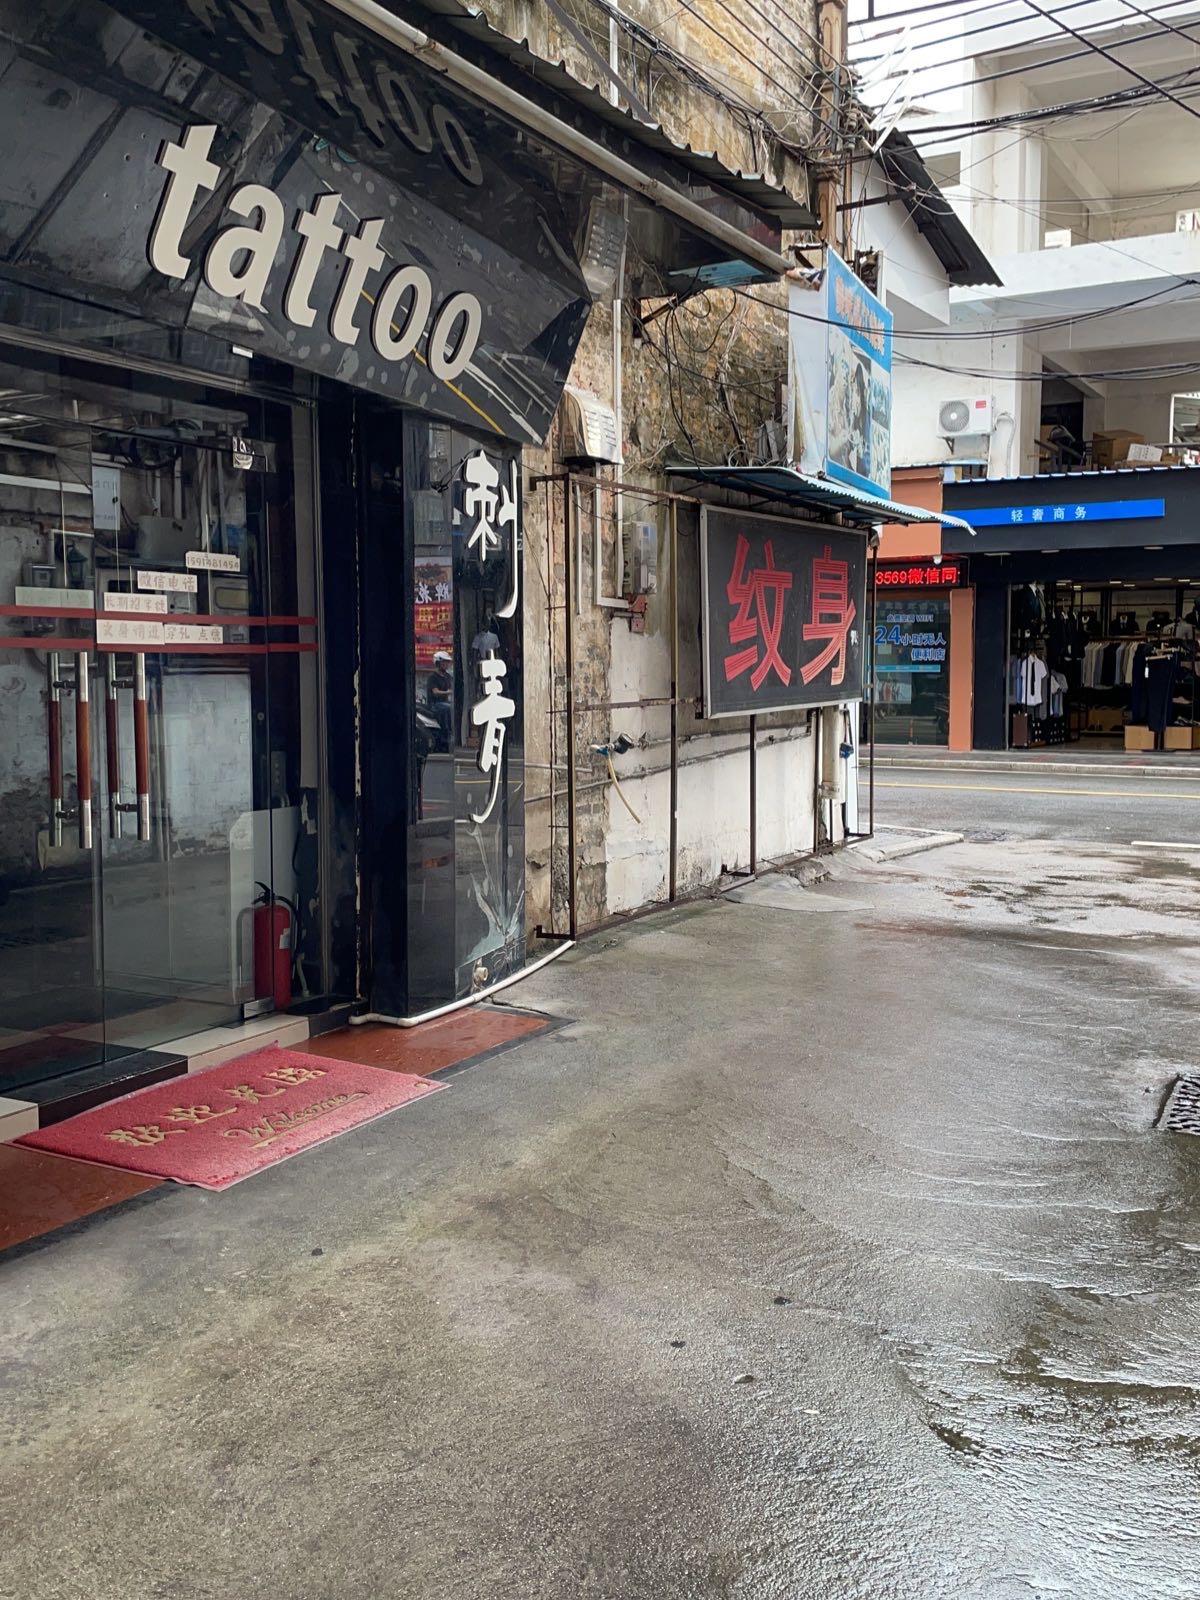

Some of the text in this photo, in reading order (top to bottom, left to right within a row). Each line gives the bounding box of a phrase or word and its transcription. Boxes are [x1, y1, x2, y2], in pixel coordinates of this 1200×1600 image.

[147, 124, 482, 381] tattoo
[1010, 506, 1087, 522] 轻奢商务
[724, 533, 857, 692] 纹身
[875, 567, 960, 585] 3569微信同
[465, 449, 519, 823] 刺青
[911, 648, 946, 661] 便利店
